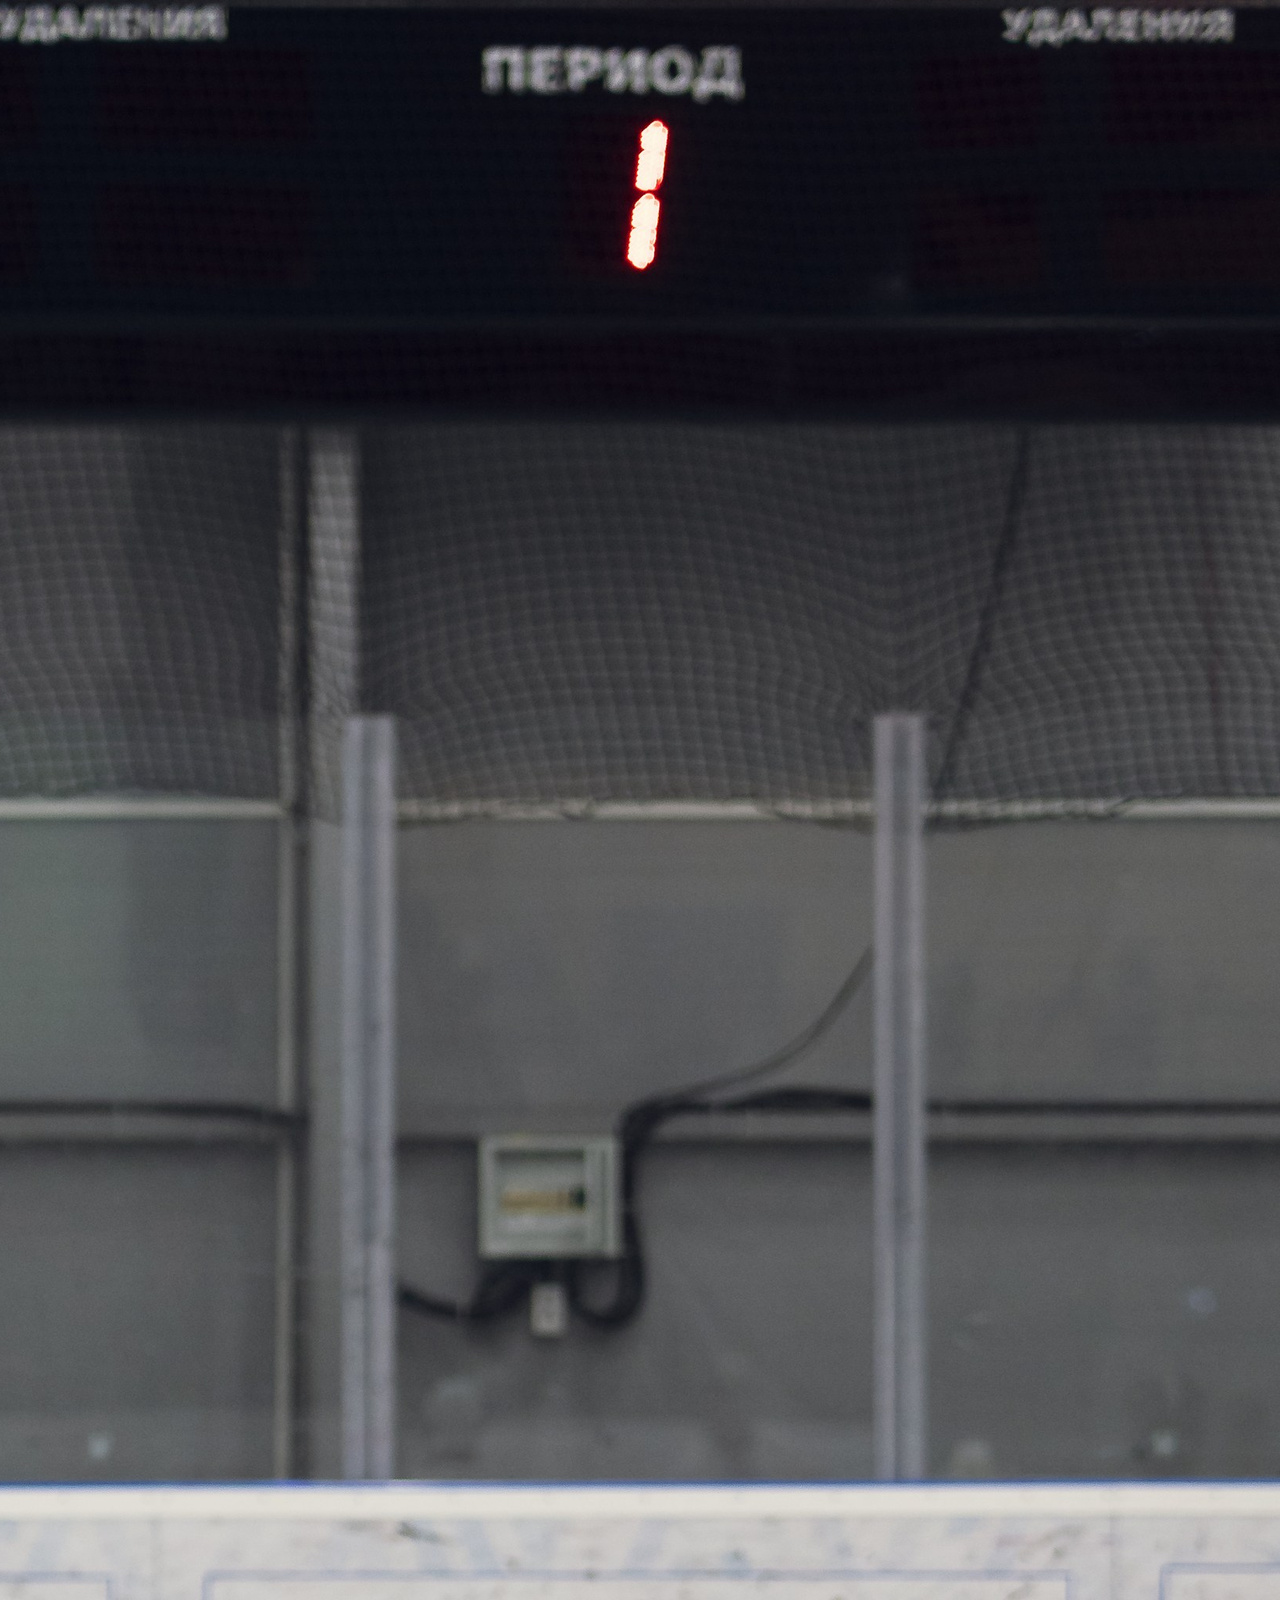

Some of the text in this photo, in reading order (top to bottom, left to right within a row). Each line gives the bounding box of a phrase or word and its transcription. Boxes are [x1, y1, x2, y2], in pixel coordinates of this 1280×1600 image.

[1000, 7, 1235, 48] УДАЛЕНИЯ
[481, 45, 745, 104] ПЕРИОД
[627, 119, 669, 270] 1
